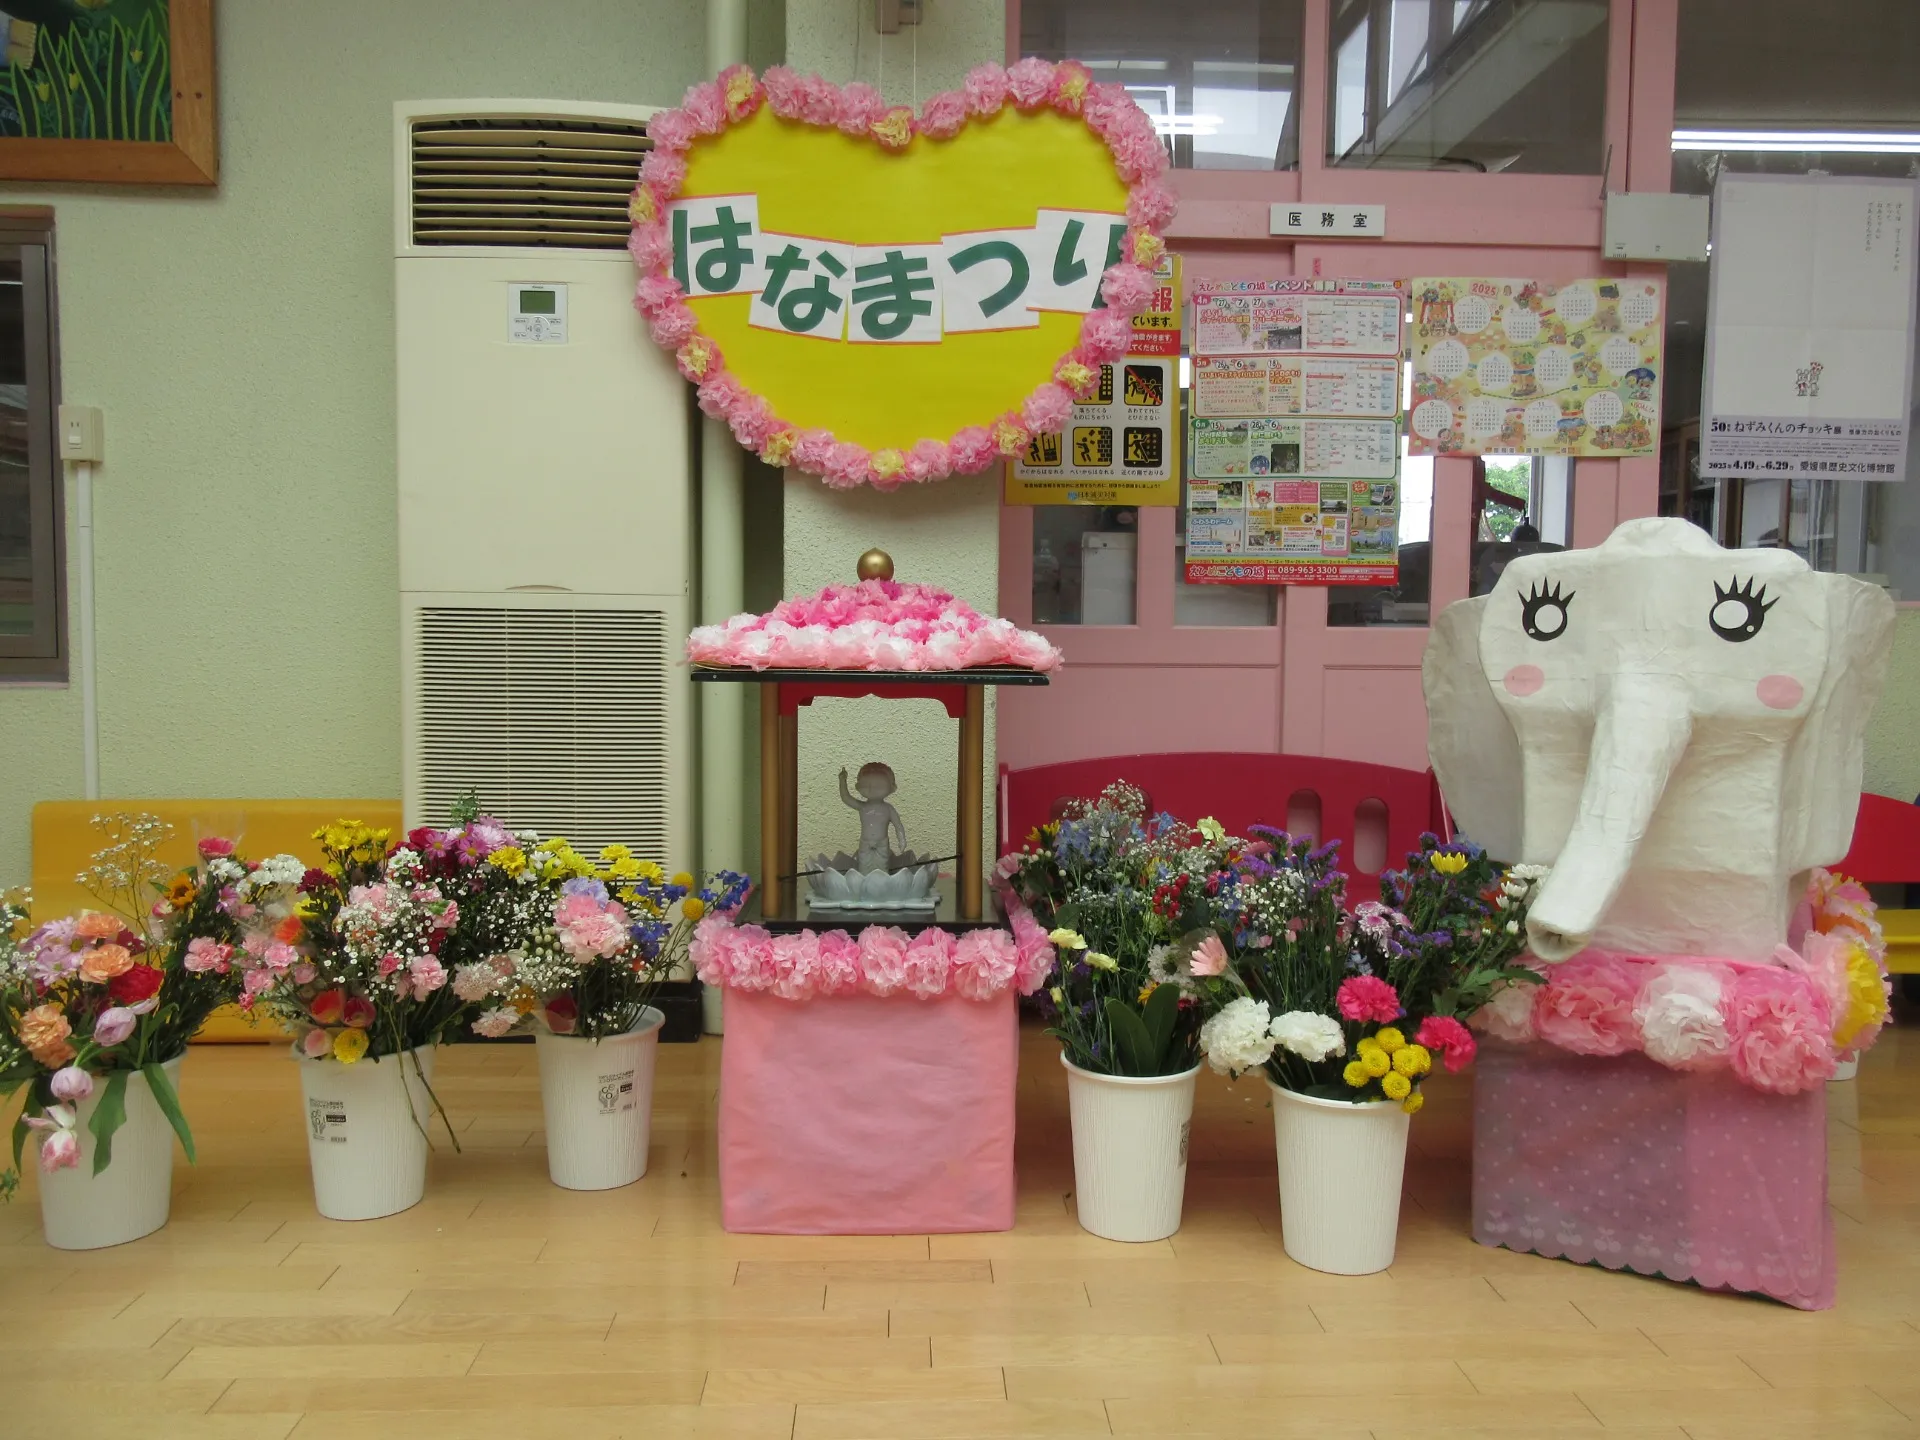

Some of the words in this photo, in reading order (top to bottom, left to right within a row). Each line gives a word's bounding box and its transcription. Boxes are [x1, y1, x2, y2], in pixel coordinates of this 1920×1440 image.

[1288, 211, 1368, 228] 医務室
[672, 205, 1128, 340] はなまつり
[1199, 282, 1266, 292] えひめこどもの城
[1472, 283, 1497, 296] 2025
[1735, 421, 1842, 434] ねずみくんのチョッキ展
[1800, 461, 1896, 474] 愛媛県歴史文化博物館
[1189, 564, 1265, 577] えひめこどもの城
[1277, 566, 1338, 574] 089-963-3300
